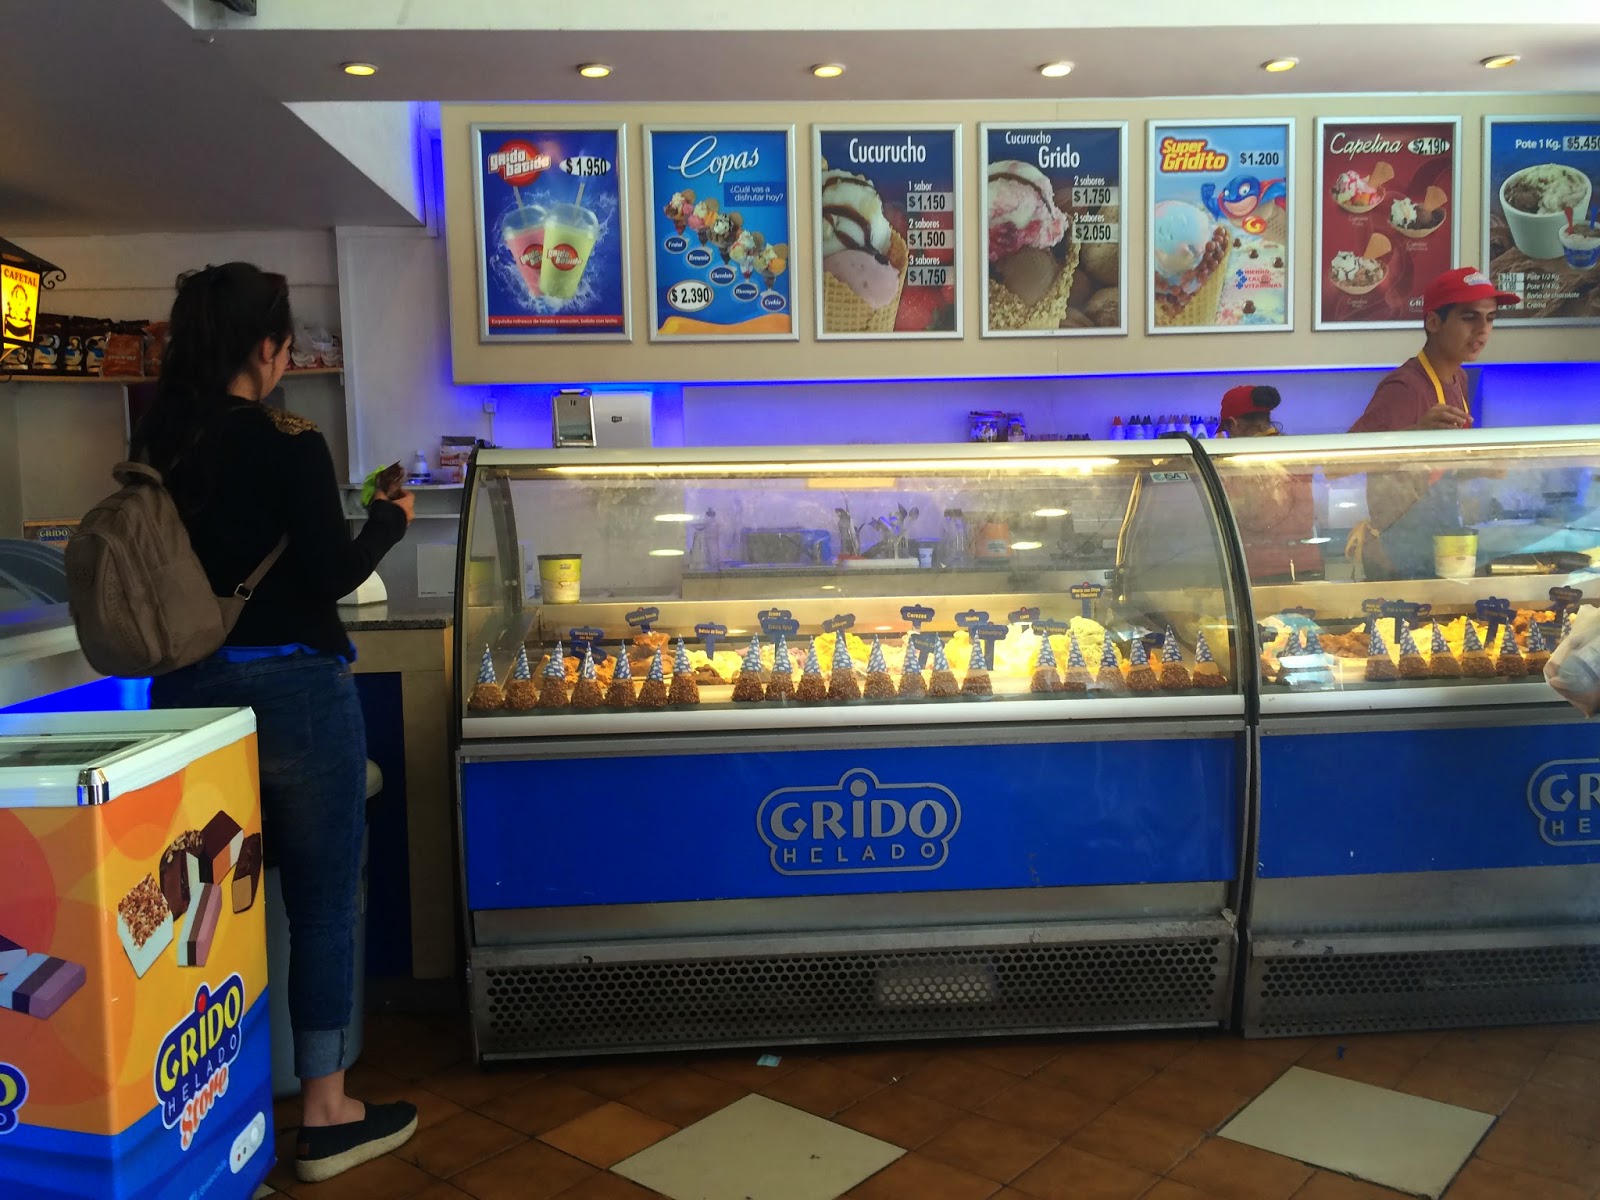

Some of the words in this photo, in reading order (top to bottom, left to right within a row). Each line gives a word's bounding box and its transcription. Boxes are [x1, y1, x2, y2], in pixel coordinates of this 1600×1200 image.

[1005, 131, 1052, 145] Cucurucho
[1162, 139, 1205, 154] Super
[1330, 132, 1403, 160] Capelina
[1412, 138, 1446, 155] $2.190
[1515, 139, 1537, 149] Pote
[1539, 139, 1544, 148] 1
[1546, 139, 1561, 150] Kg.
[849, 136, 927, 163] Cucurucho
[1038, 143, 1080, 169] Grido
[566, 157, 573, 175] $
[577, 157, 607, 176] 1.950
[668, 135, 760, 184] Copas
[1163, 153, 1227, 170] Gridito
[1240, 152, 1279, 165] $1.200
[908, 181, 912, 190] 1
[913, 180, 932, 191] sabor
[1074, 176, 1079, 186] 2
[1080, 175, 1105, 186] sabores
[734, 193, 764, 202] disfrutar
[765, 193, 784, 203] hoy?
[908, 194, 946, 210] $1.150
[1074, 188, 1111, 204] $1.750
[908, 219, 914, 229] 2
[915, 218, 940, 229] sabores
[1074, 213, 1079, 223] 3
[1080, 212, 1105, 223] sabores
[909, 231, 946, 247] $1.500
[1075, 224, 1111, 241] $2.050
[908, 256, 914, 265] 3
[915, 255, 940, 266] sabores
[4, 268, 37, 287] CAFETAL
[909, 268, 946, 285] $1.750
[671, 288, 678, 303] $
[681, 287, 710, 304] 2.390
[39, 529, 68, 537] GRIDO
[1540, 772, 1600, 812] GR
[770, 779, 948, 841] GRIDO
[783, 842, 936, 864] HELADO
[160, 985, 241, 1093] GRIDO
[168, 1033, 237, 1118] HELADO
